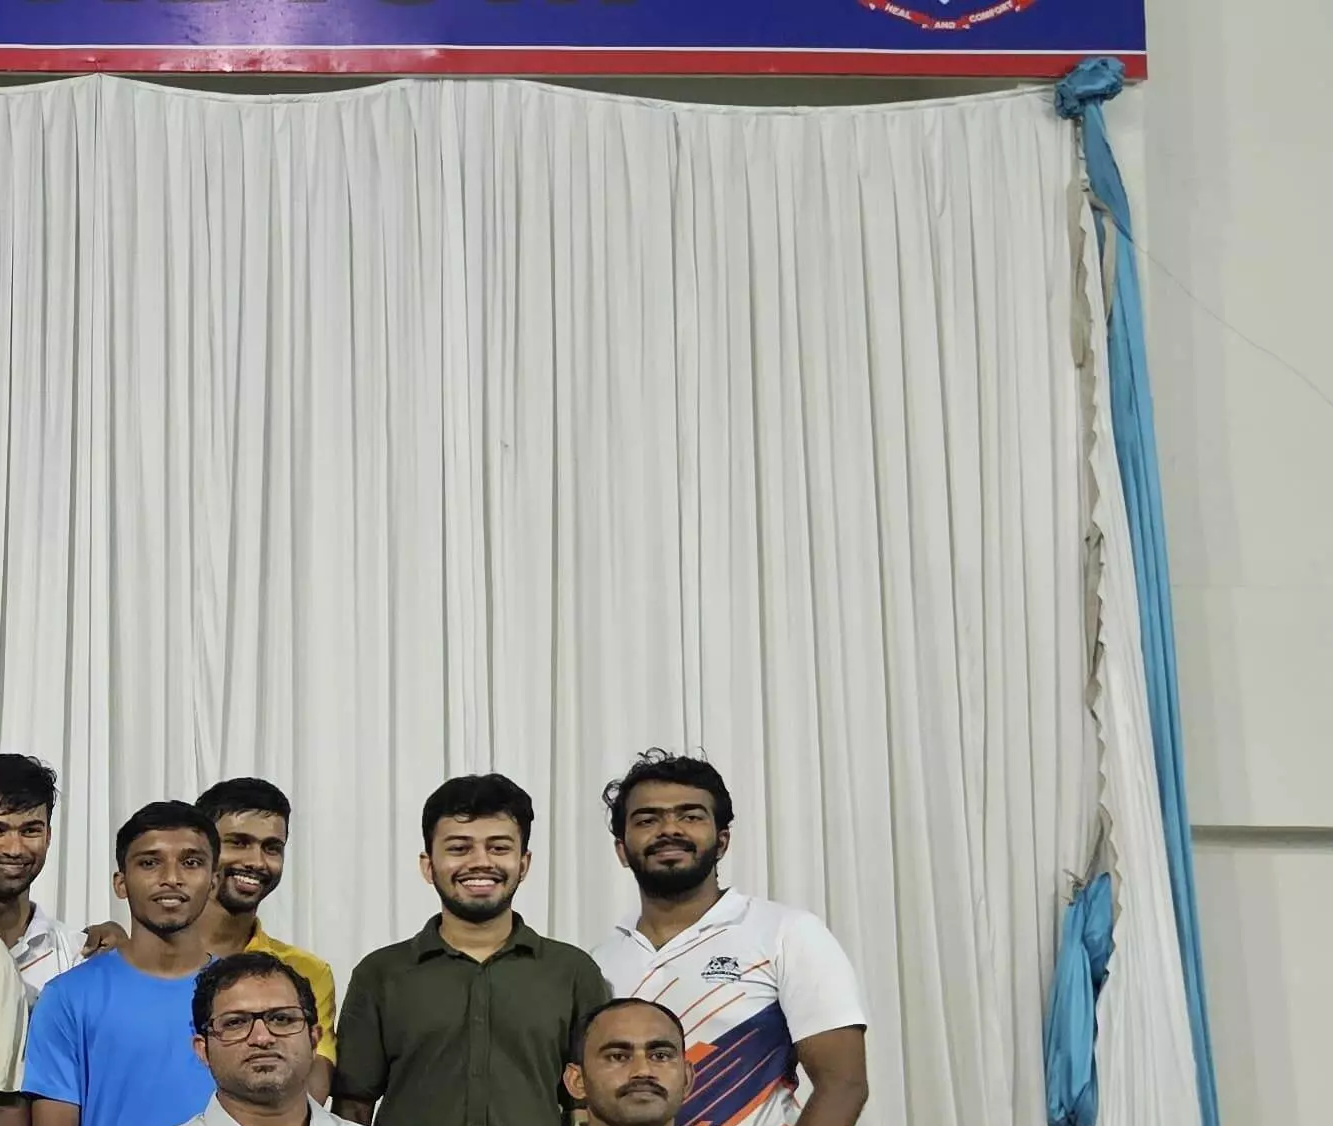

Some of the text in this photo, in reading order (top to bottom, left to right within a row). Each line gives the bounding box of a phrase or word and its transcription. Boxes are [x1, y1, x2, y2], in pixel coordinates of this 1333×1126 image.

[885, 1, 1014, 29] HEAL AND COMFORT
